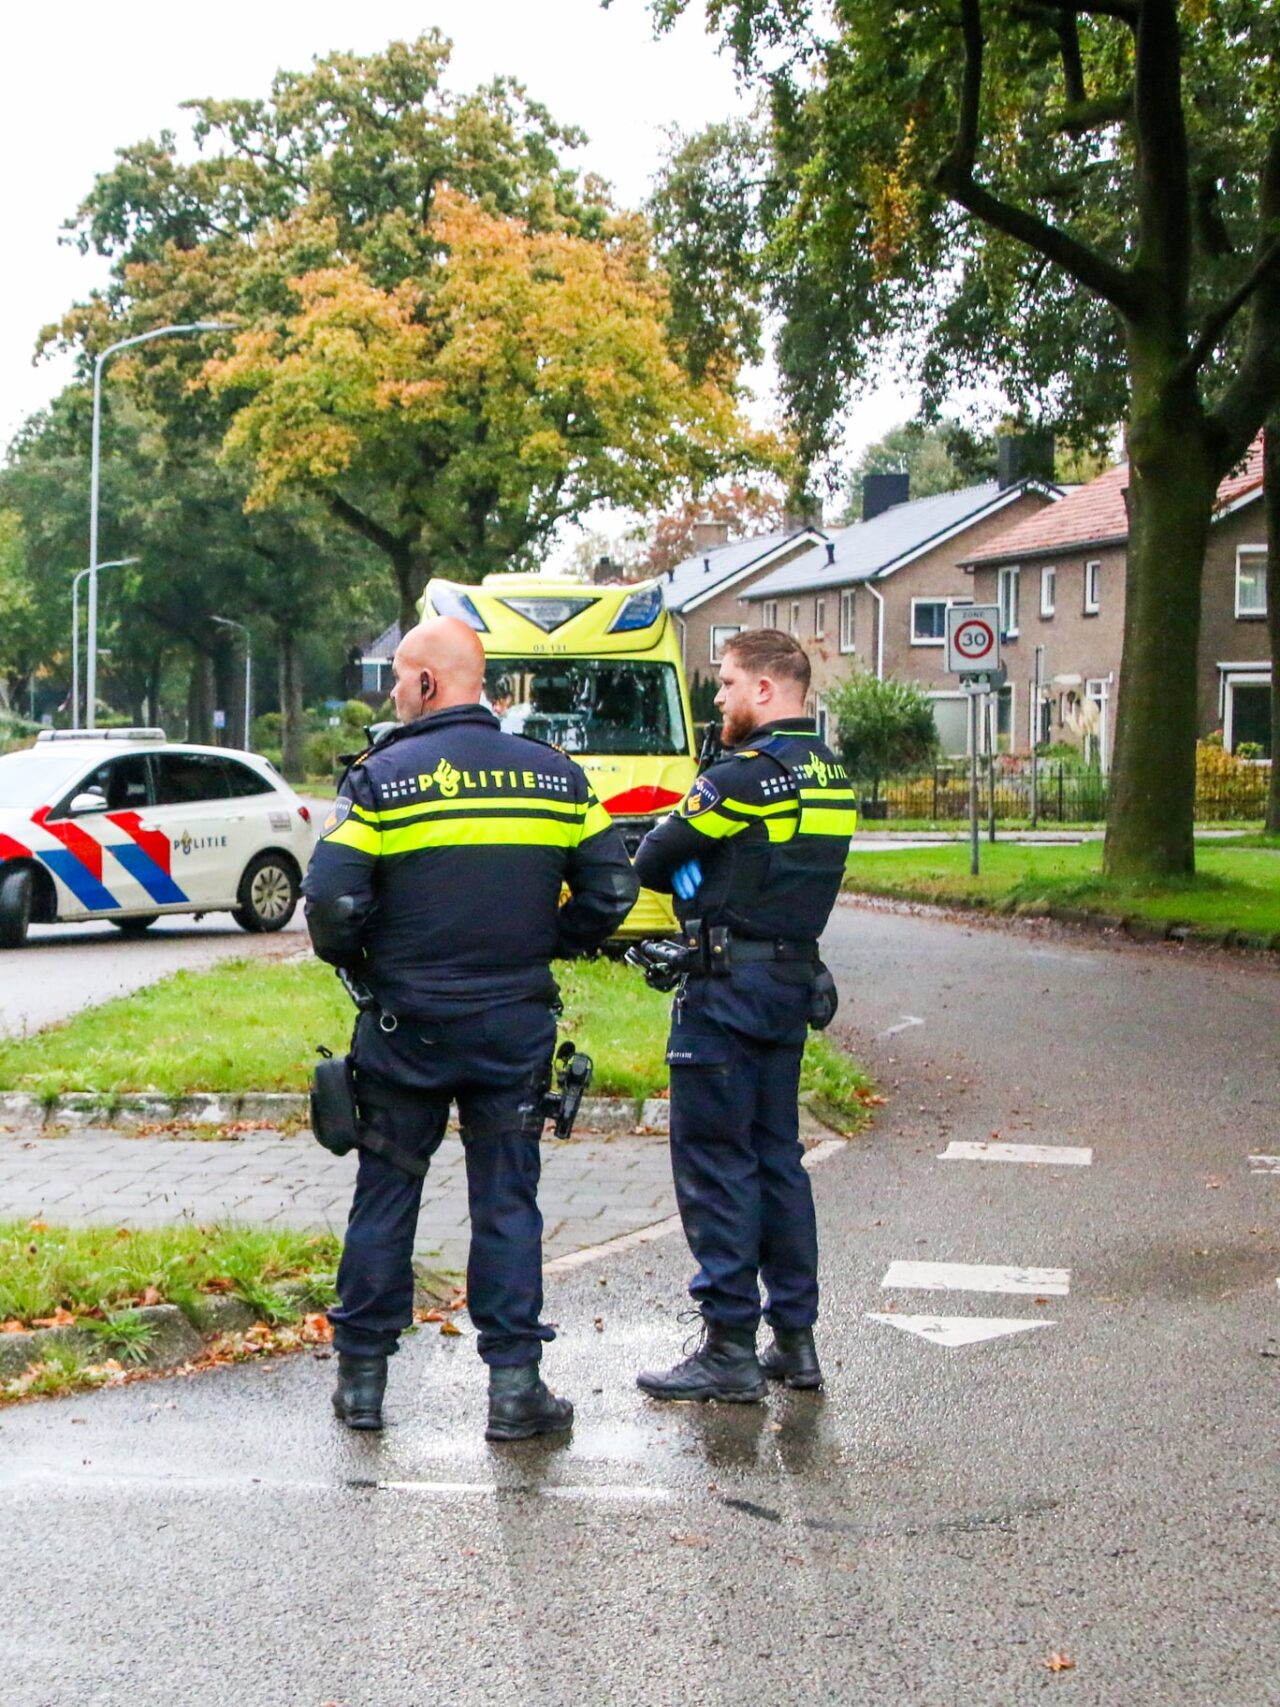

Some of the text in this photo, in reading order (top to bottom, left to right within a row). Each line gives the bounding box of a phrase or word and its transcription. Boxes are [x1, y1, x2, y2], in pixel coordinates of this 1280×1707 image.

[962, 611, 985, 619] ZONE
[961, 632, 987, 648] 30
[417, 757, 537, 798] POLITIE
[173, 829, 228, 856] POLITIE
